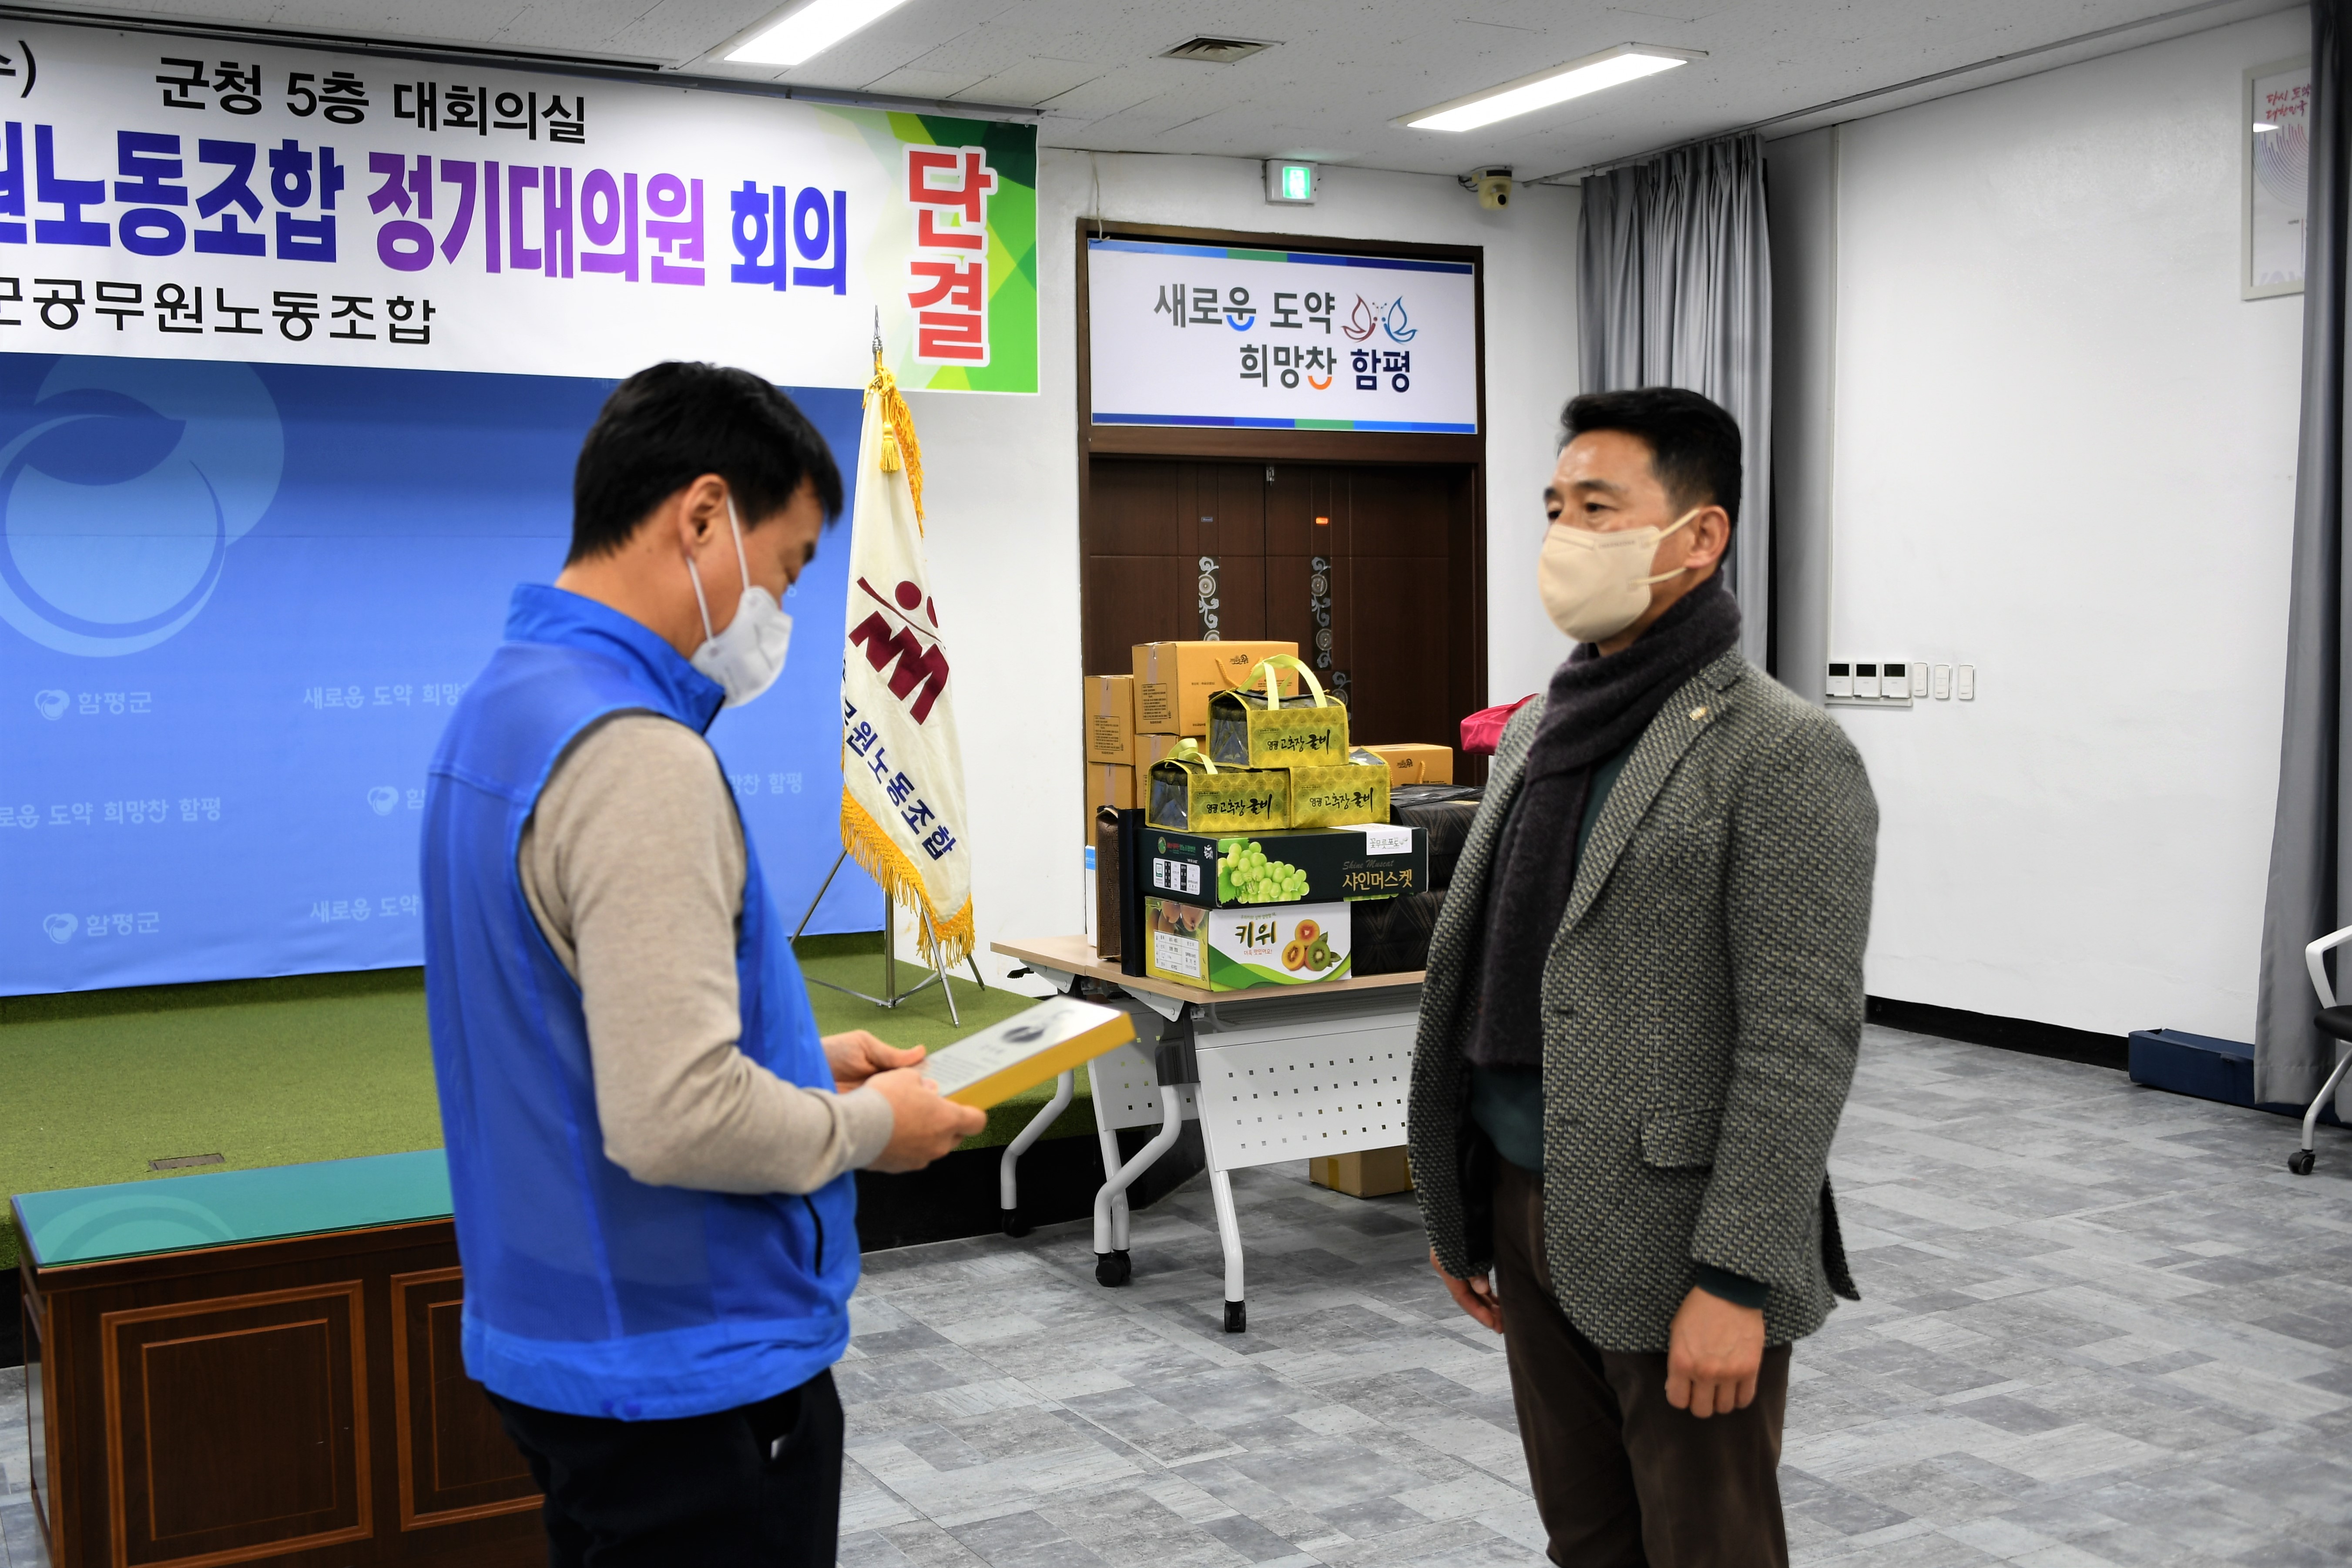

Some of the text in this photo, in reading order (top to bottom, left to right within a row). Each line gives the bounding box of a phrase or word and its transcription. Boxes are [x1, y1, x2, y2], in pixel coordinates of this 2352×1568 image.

[155, 56, 262, 115] 군청
[286, 71, 370, 125] 5층
[393, 82, 586, 145] 대회의실
[367, 151, 705, 286] 정기대의원
[730, 180, 847, 296] 회의
[907, 149, 992, 360] 단결
[1153, 283, 1335, 334] 새로운 도약
[1239, 344, 1411, 393] 희망찬 함평
[77, 691, 152, 715] 함평군
[303, 682, 469, 710] 새로운 도약 희망
[1267, 729, 1331, 755] 영광 고추장 굴비
[767, 772, 802, 795] 함평
[48, 802, 94, 826] 도약
[104, 799, 169, 825] 희망찬
[178, 796, 221, 823] 함평
[1206, 793, 1273, 820] 영광 고추장 굴비
[1309, 786, 1374, 813] 영광 고추장 굴비
[1342, 859, 1395, 870] Shine Muscat
[1342, 869, 1413, 892] 샤인머스켓
[309, 894, 419, 923] 새로운 도약
[86, 912, 160, 937] 함평군
[1235, 920, 1277, 949] 키위
